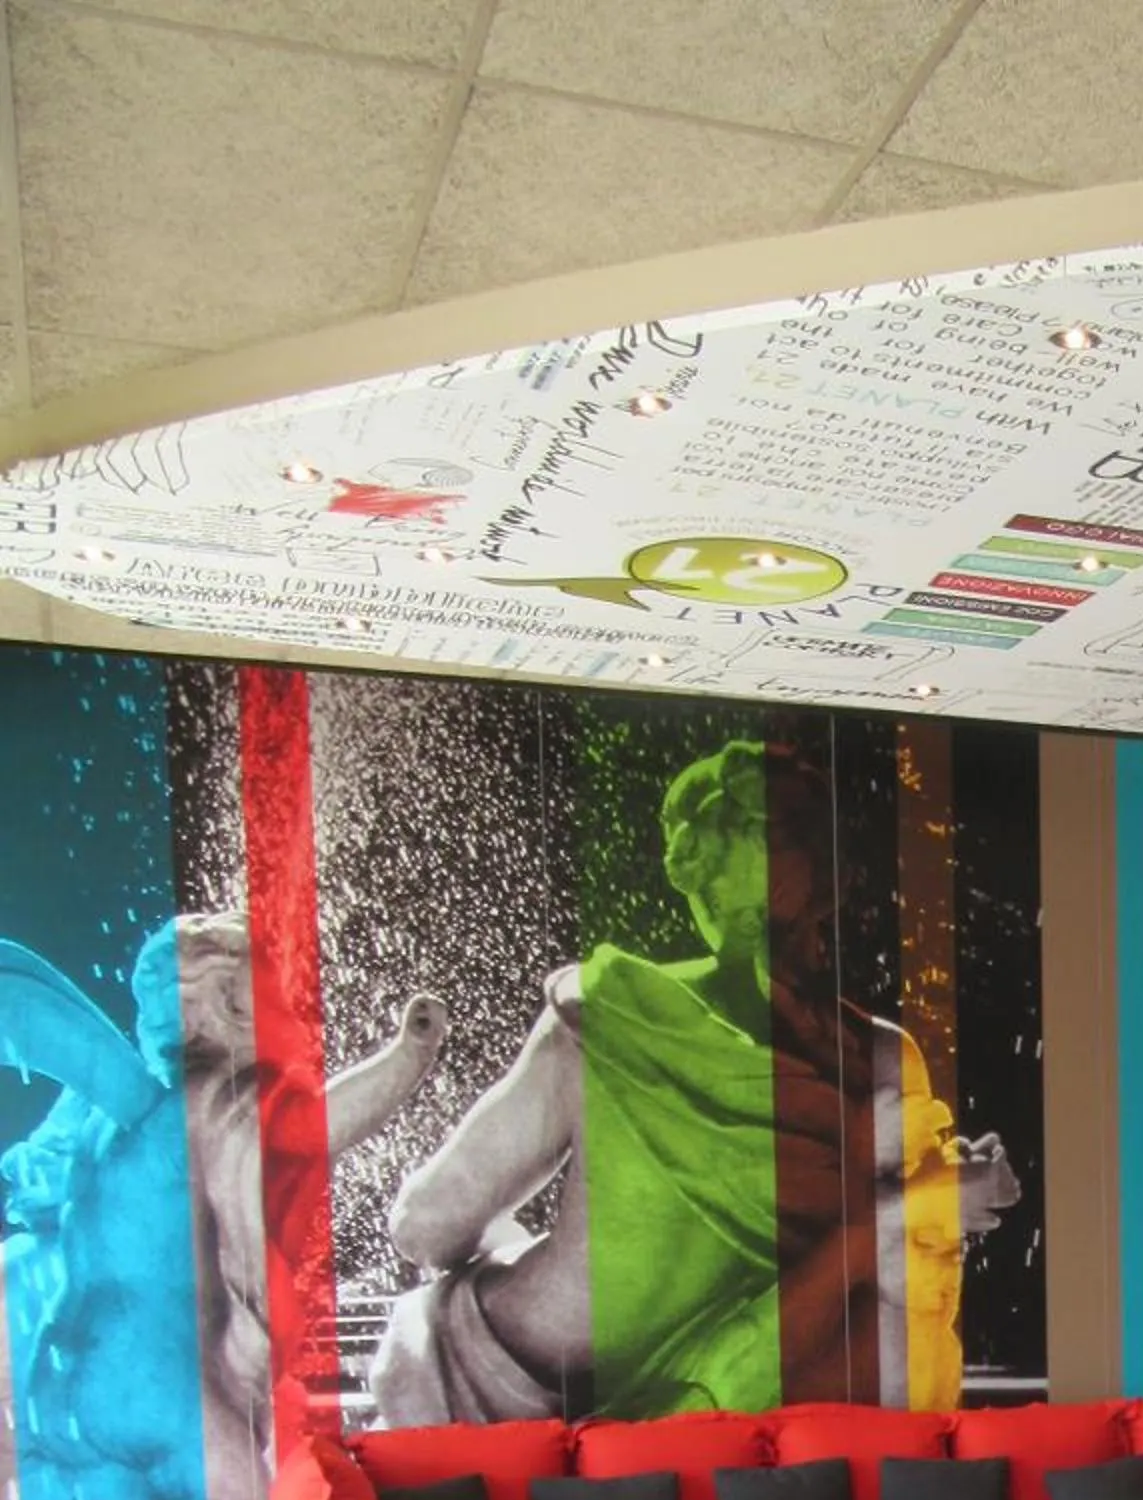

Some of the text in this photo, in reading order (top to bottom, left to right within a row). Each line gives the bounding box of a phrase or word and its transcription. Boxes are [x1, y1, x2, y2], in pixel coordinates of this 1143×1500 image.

[819, 357, 912, 383] made
[974, 409, 1052, 436] With
[662, 583, 904, 627] PLANET
